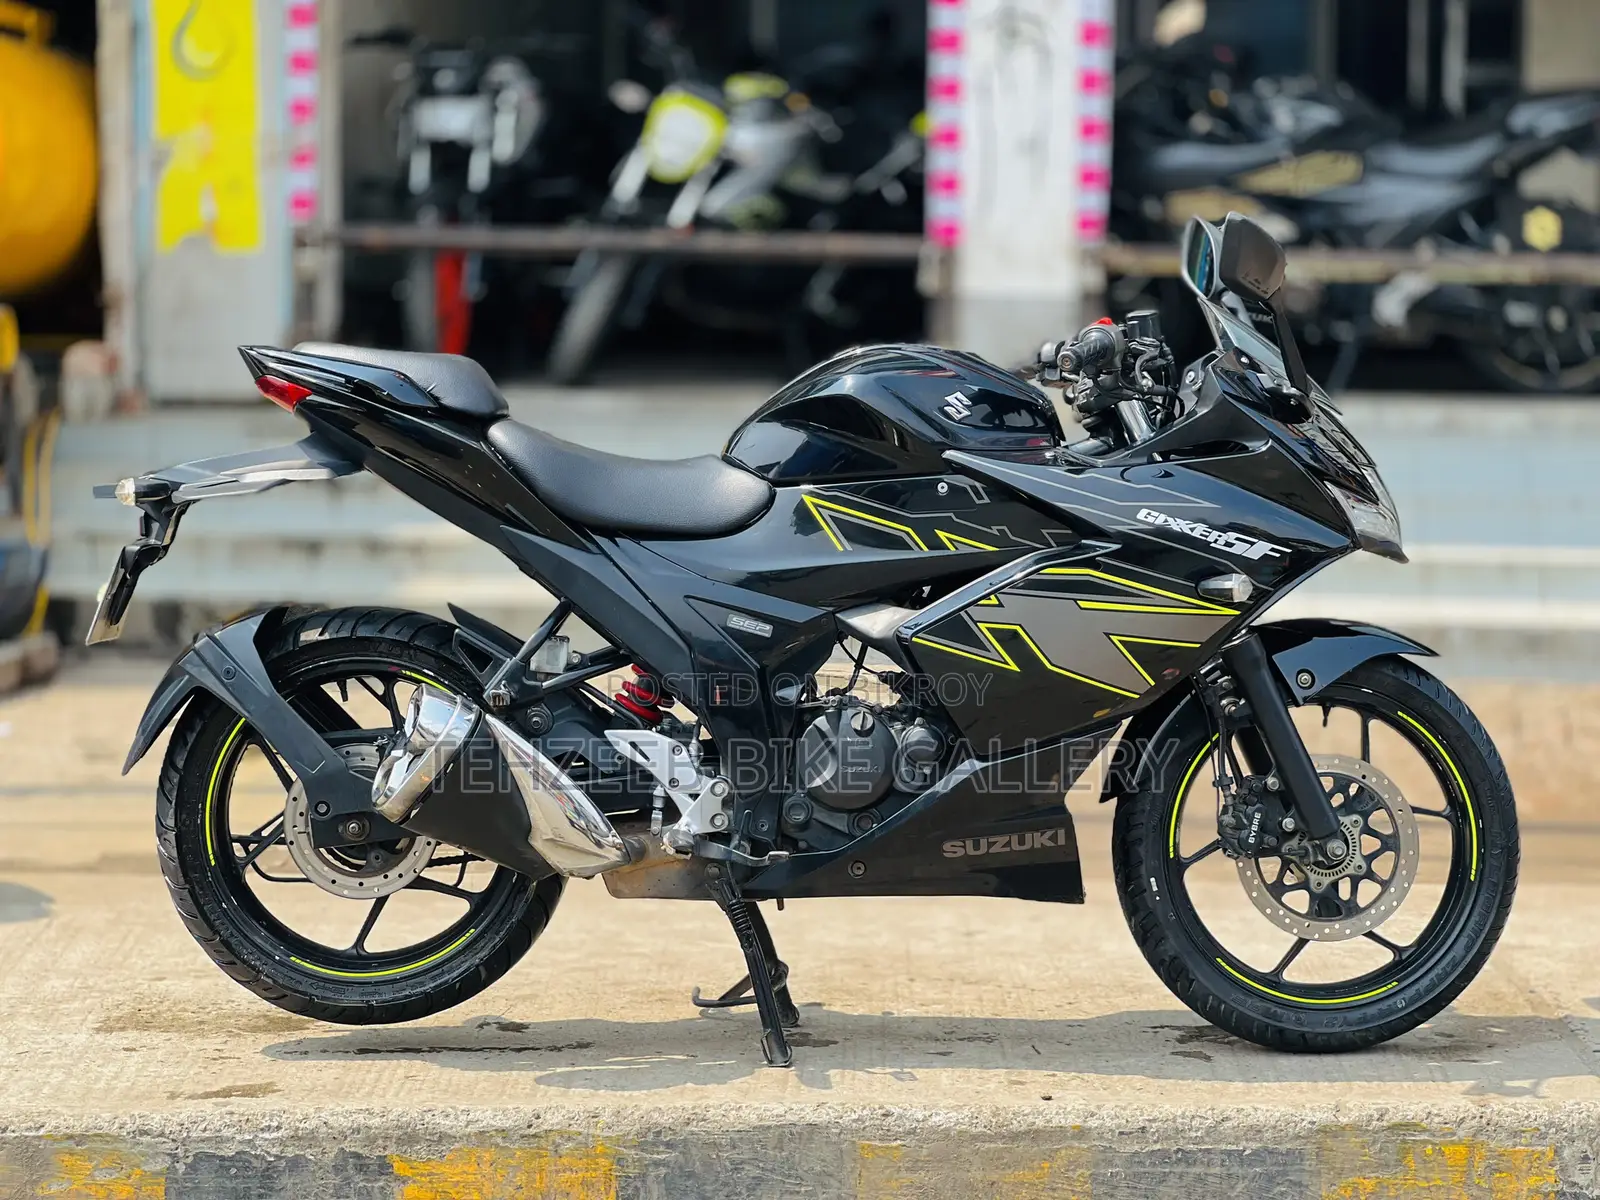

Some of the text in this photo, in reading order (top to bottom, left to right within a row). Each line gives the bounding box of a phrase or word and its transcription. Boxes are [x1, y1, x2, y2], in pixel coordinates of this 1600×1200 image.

[730, 616, 770, 631] SEP
[941, 828, 1066, 858] SUZUKI
[1248, 812, 1261, 844] BYBRE
